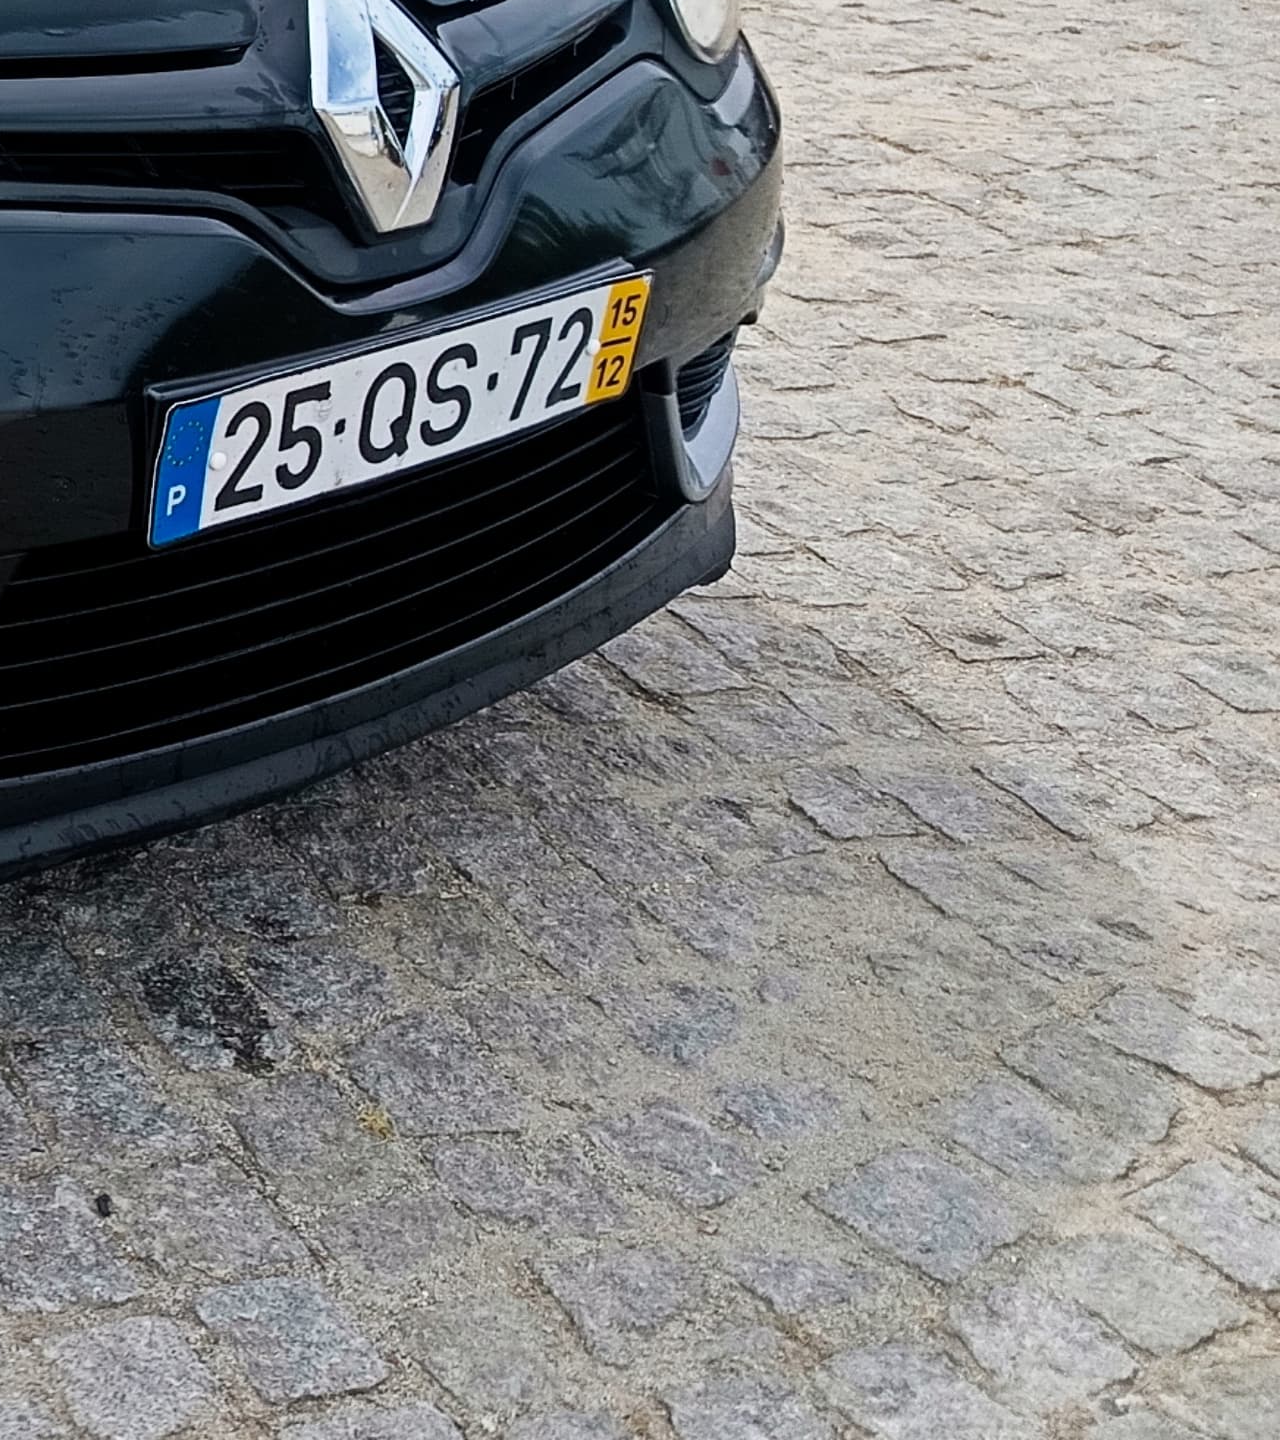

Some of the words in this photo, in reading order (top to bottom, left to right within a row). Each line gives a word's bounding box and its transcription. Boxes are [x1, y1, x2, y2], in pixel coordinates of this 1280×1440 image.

[611, 293, 642, 329] 15
[595, 354, 626, 389] 12
[166, 483, 187, 516] P
